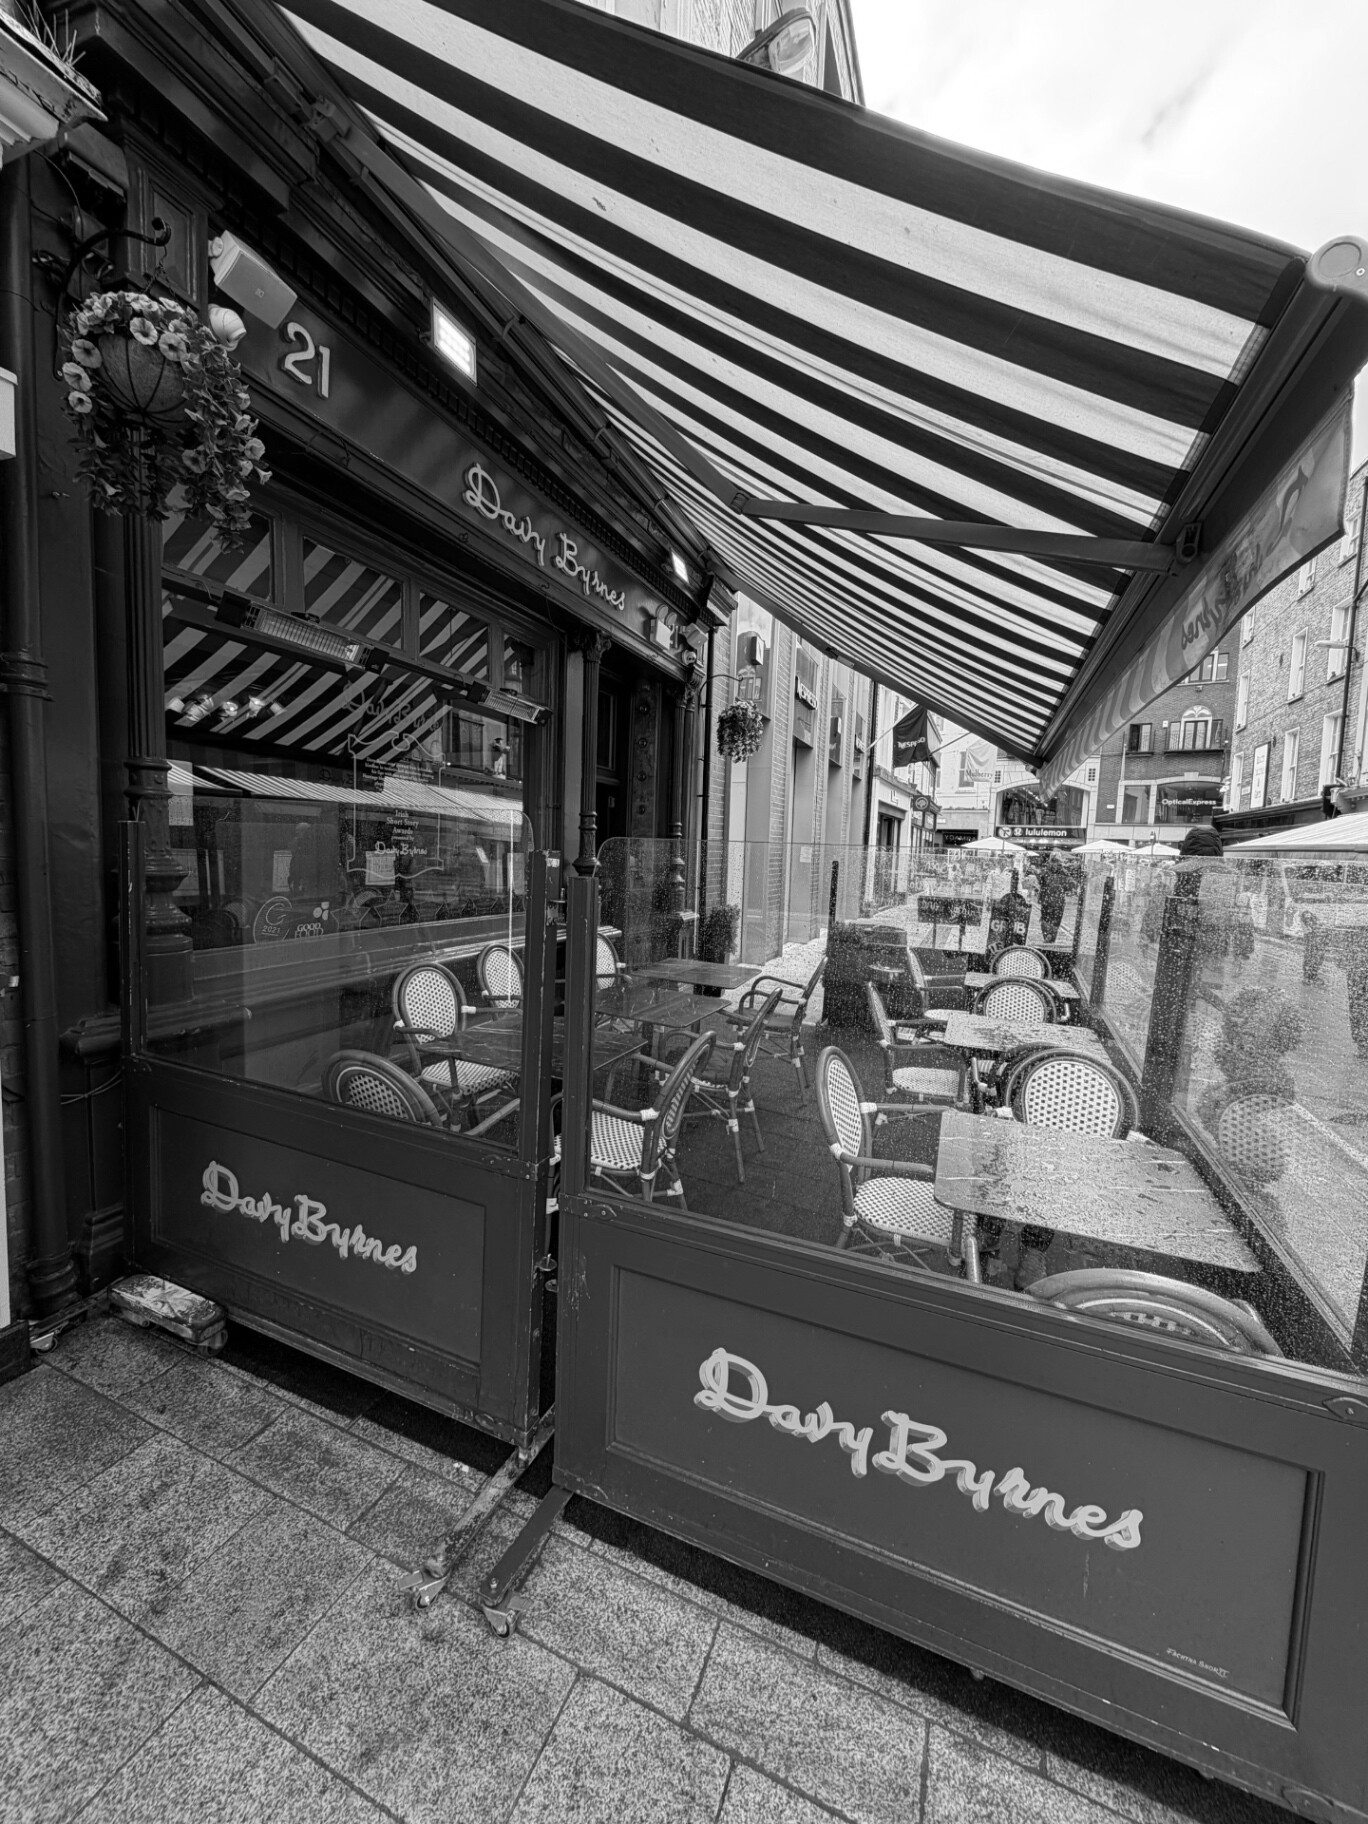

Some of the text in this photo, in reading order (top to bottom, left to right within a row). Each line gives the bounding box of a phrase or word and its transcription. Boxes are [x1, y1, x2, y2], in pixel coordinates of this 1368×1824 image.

[284, 321, 330, 398] 21
[463, 462, 626, 611] Davy Byrnes
[965, 768, 993, 780] Mulberry
[394, 809, 409, 817] Irish
[386, 816, 419, 829] Short Story
[392, 826, 413, 835] Awards
[1025, 828, 1067, 837] lululemon
[374, 840, 428, 857] Davy Byrnes
[261, 925, 281, 934] 2021
[296, 922, 321, 932] GOOD
[200, 1160, 418, 1275] Davy Byrnes
[693, 1347, 1143, 1551] Davy Byrnes
